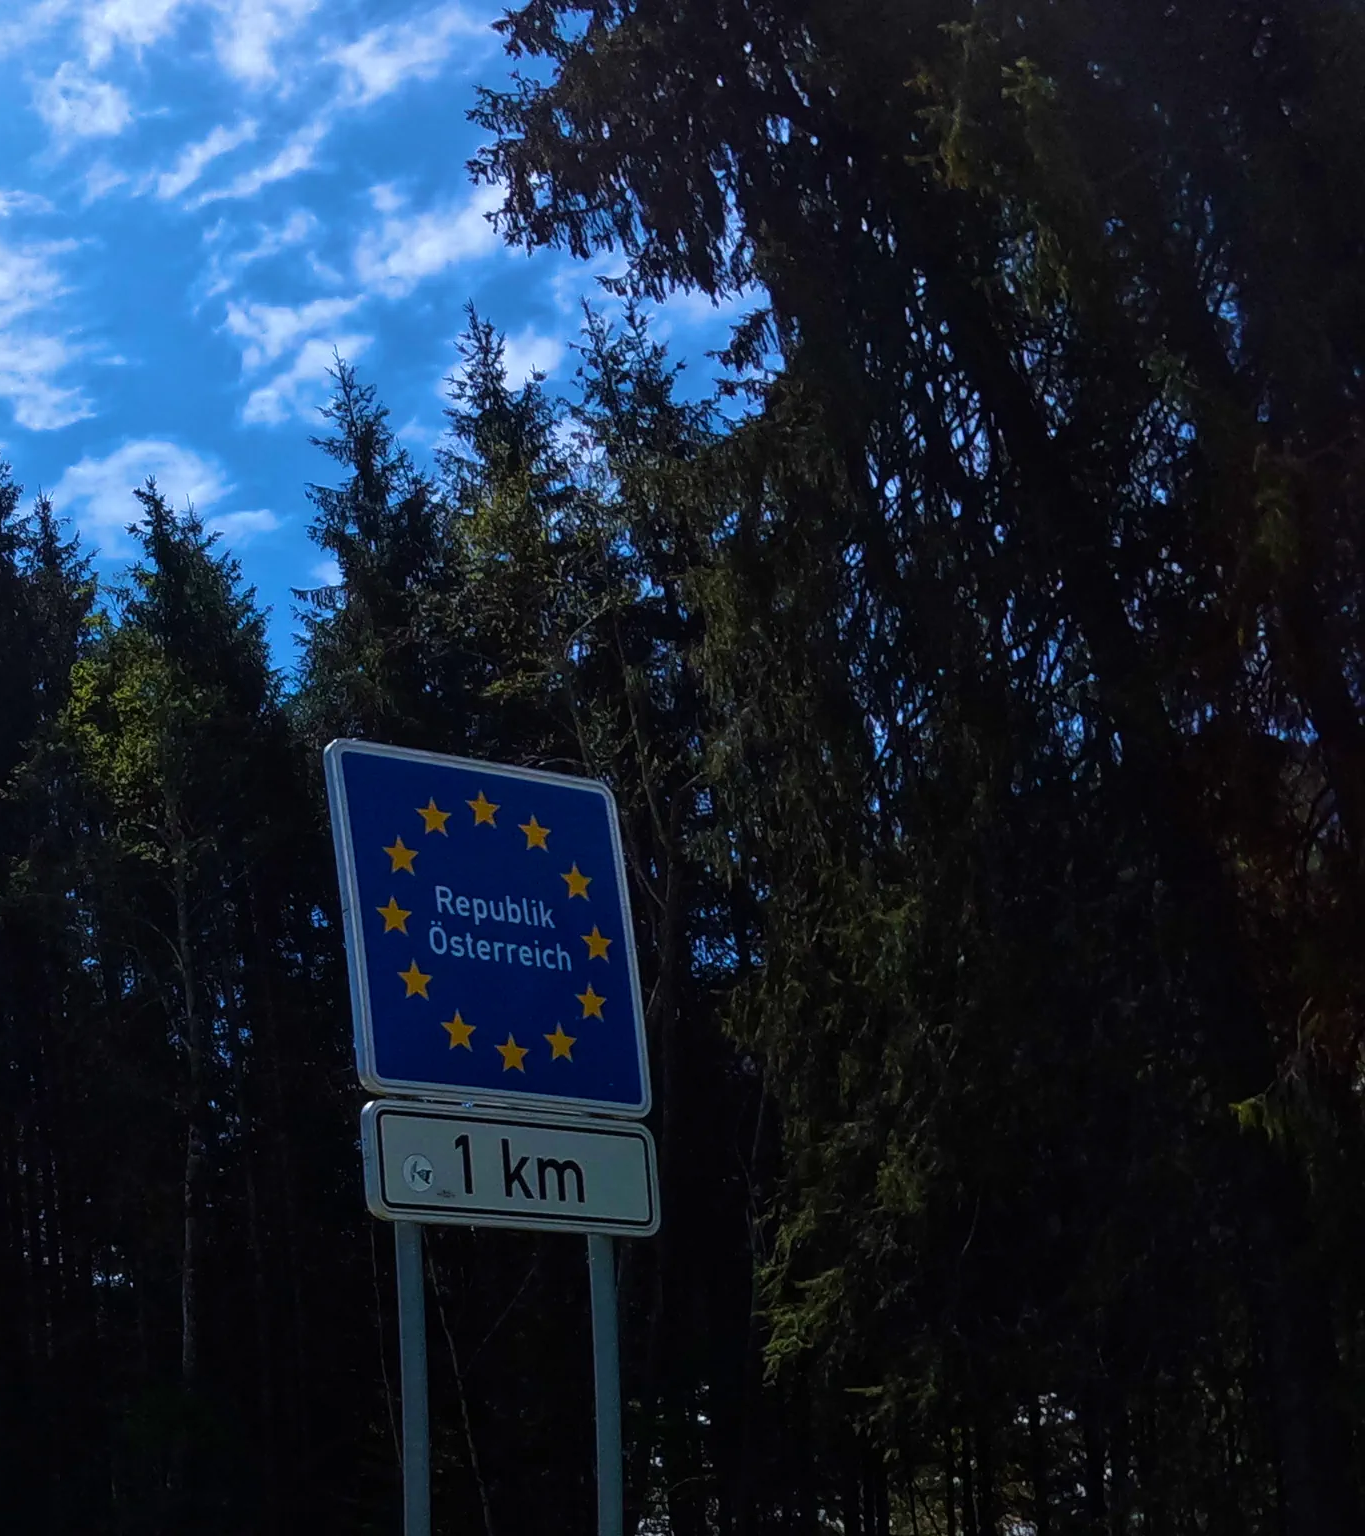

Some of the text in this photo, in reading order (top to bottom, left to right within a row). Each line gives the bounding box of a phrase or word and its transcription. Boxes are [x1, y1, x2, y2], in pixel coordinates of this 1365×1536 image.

[434, 885, 556, 929] Republik
[428, 920, 572, 972] Österreich
[453, 1134, 585, 1203] 1 km
